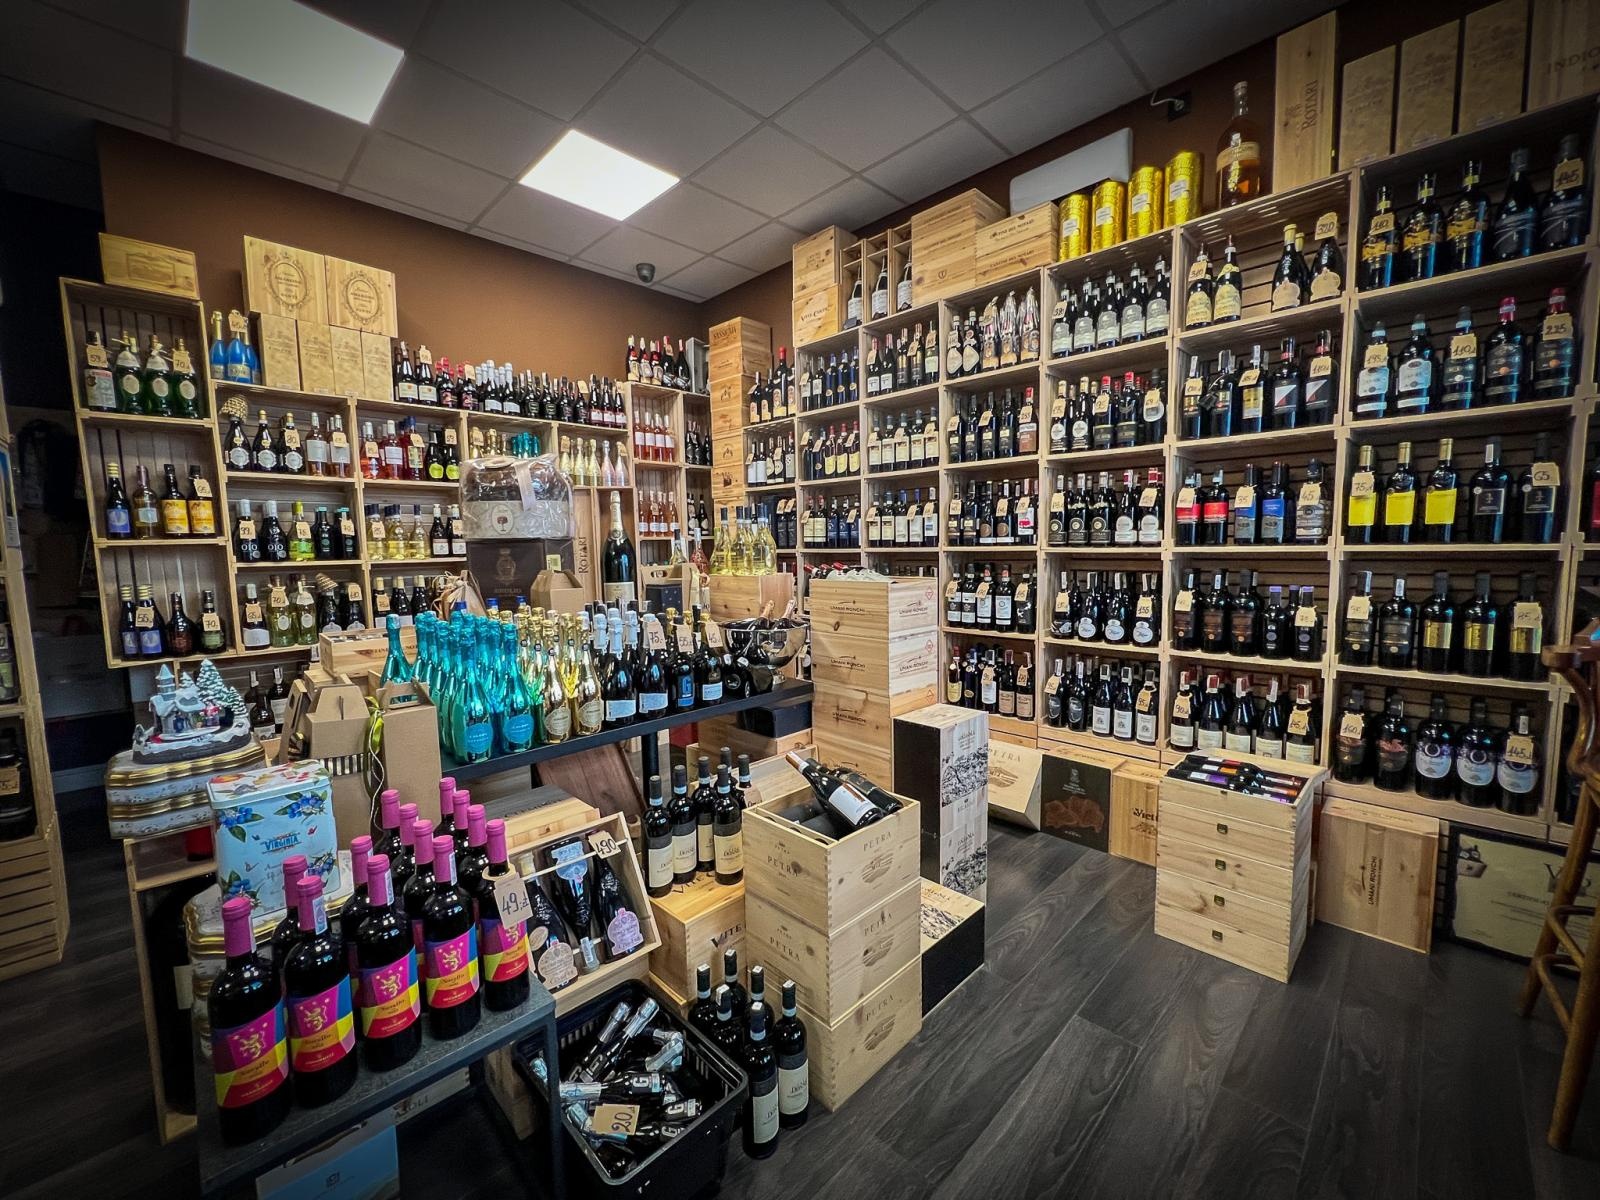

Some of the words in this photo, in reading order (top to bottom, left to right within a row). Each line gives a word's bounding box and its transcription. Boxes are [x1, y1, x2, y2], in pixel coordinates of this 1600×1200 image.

[1301, 79, 1318, 131] ROTARI
[577, 536, 589, 574] ROTARI
[264, 834, 299, 851] VIRGINIA
[595, 837, 617, 855] 490
[863, 831, 891, 852] PETRA
[767, 855, 799, 877] PETRA
[770, 936, 800, 961] PETRA
[633, 1076, 649, 1088] G
[667, 1102, 684, 1115] G
[611, 1112, 632, 1132] 20
[661, 1126, 678, 1138] G
